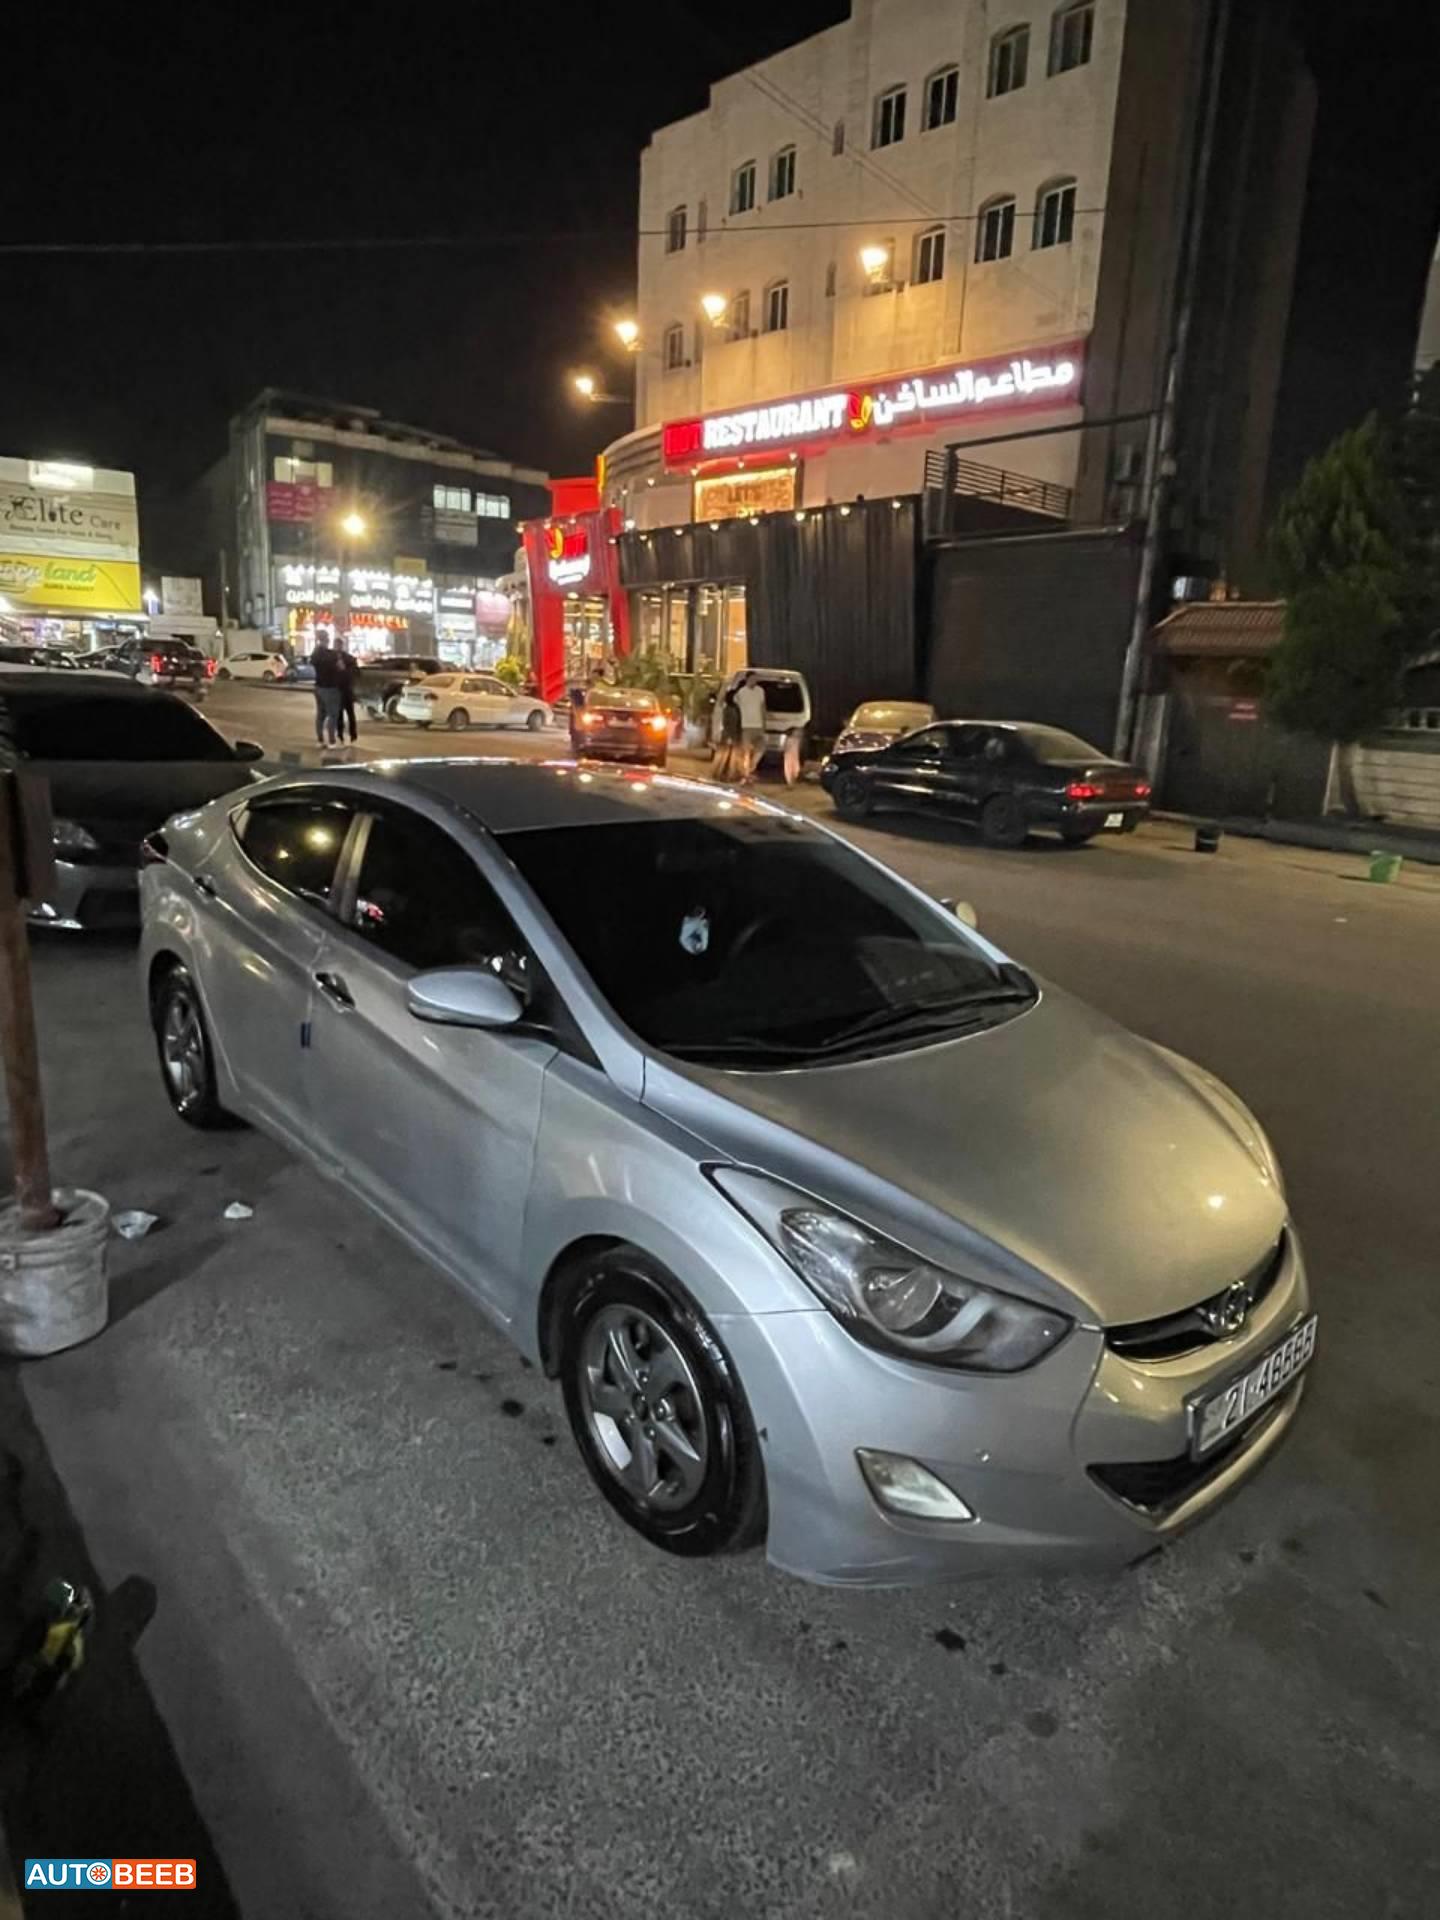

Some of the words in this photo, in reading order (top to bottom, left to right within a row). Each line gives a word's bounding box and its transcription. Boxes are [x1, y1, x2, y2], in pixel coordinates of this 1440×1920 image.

[873, 370, 974, 426] الساخن
[975, 360, 1075, 403] مطاعم
[703, 394, 849, 450] RESTAURANT
